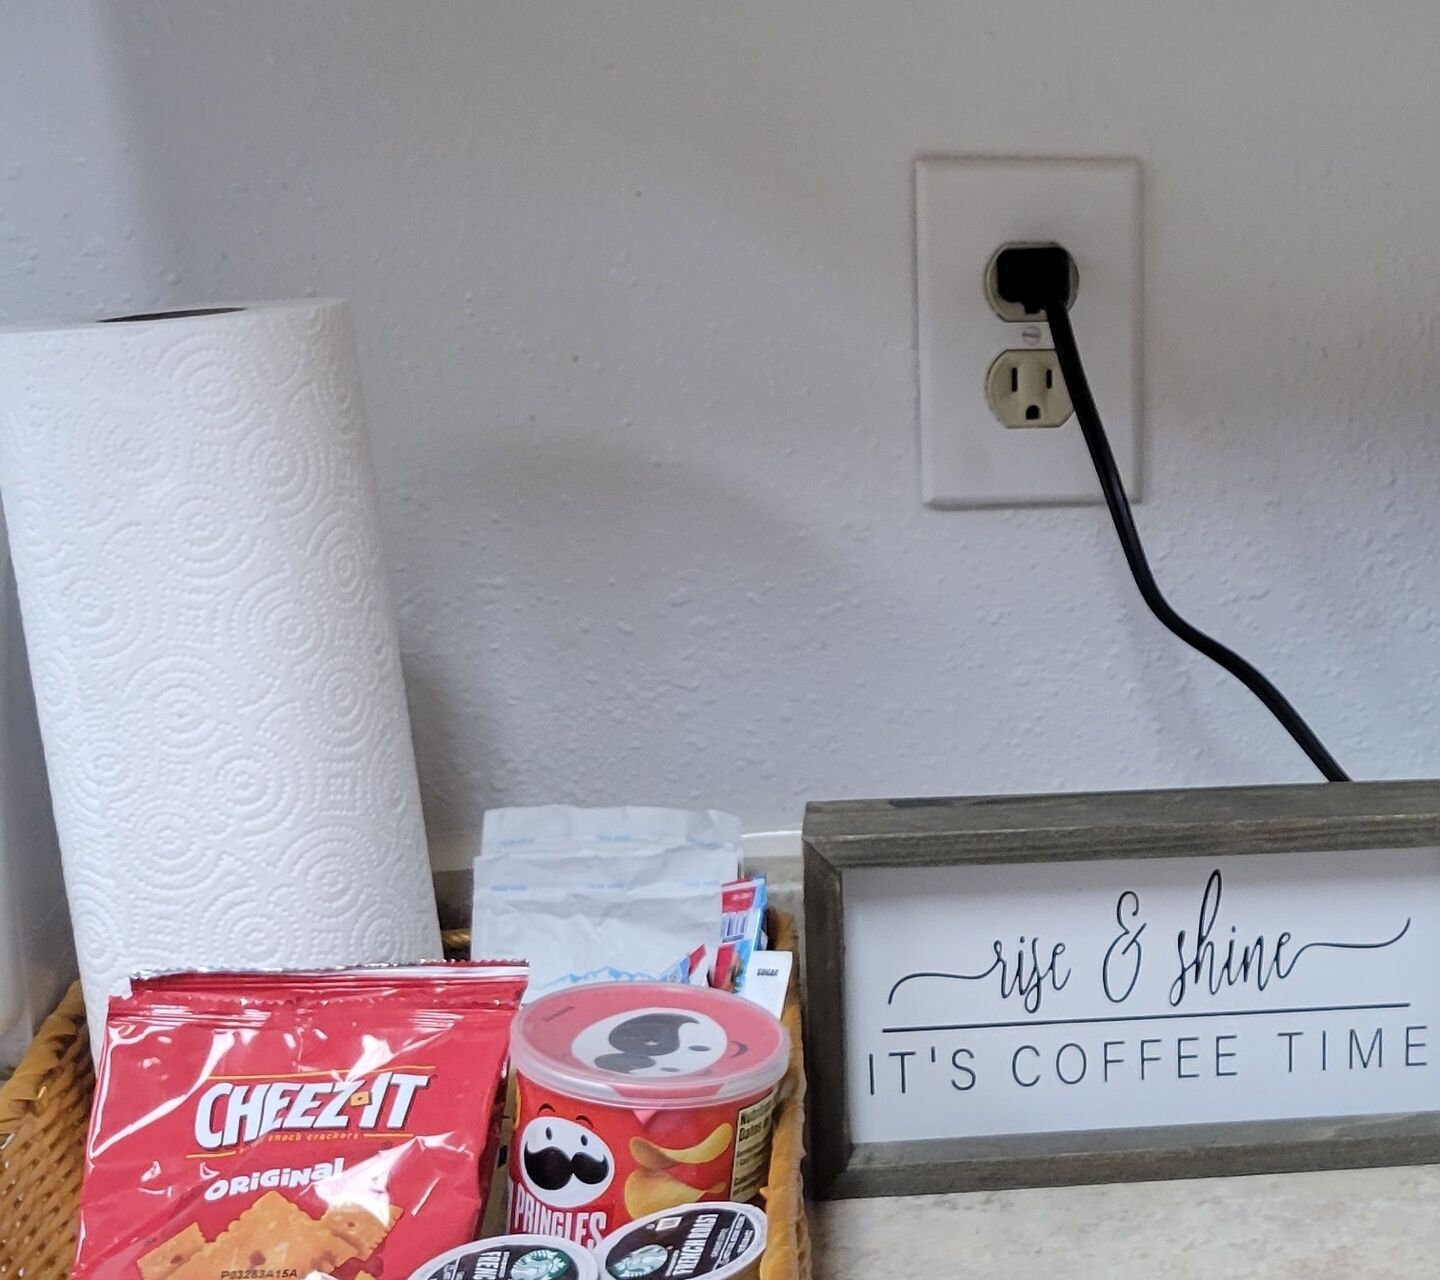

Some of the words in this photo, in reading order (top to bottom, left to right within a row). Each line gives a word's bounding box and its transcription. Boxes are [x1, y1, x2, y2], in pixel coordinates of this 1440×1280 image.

[1102, 890, 1147, 1003] &
[1169, 868, 1411, 1007] shine
[866, 1046, 978, 1096] IT'S
[1011, 1033, 1239, 1088] COFFEE
[1277, 1024, 1429, 1074] TIME
[514, 1181, 607, 1250] PRINGLES
